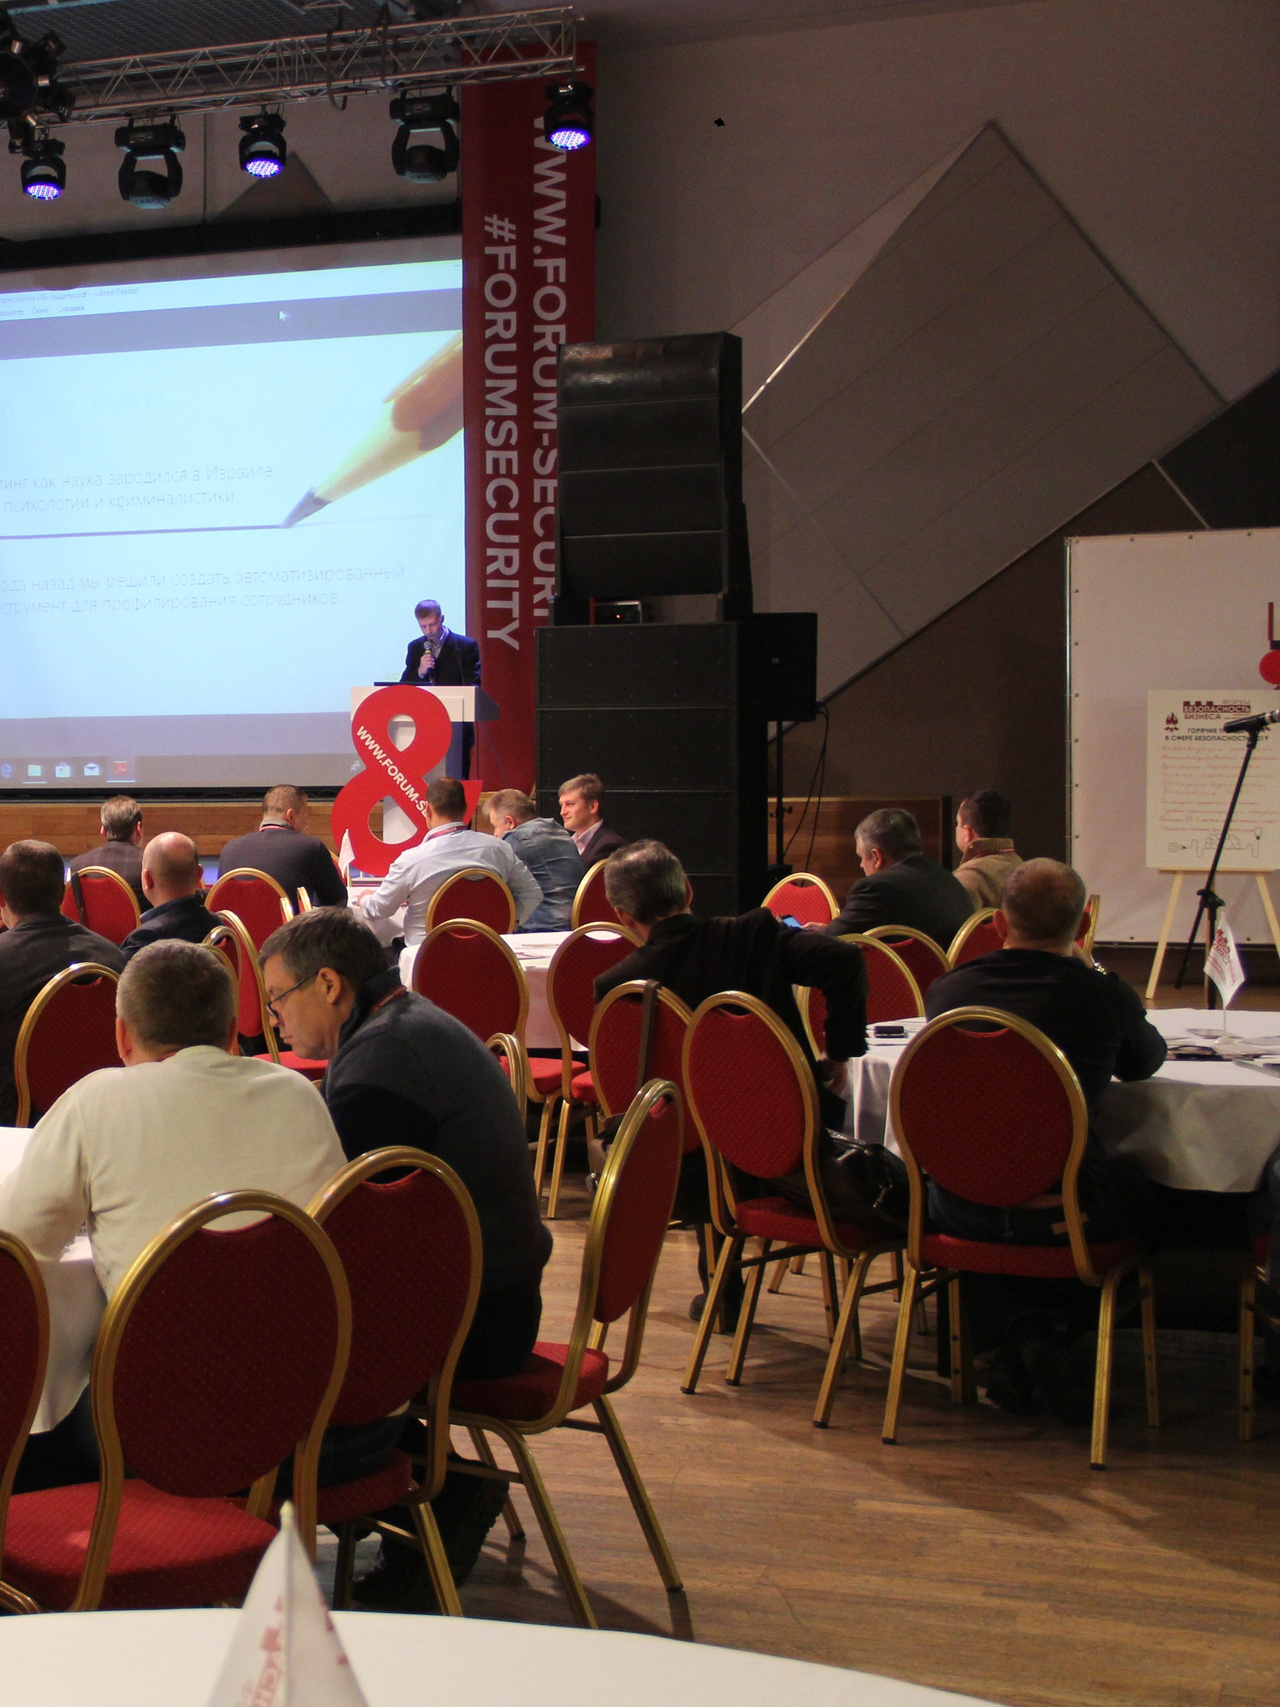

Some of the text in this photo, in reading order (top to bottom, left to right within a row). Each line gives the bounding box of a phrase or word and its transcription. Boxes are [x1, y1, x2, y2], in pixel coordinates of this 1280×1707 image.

[33, 477, 55, 488] как
[61, 475, 103, 490] наука
[108, 470, 186, 487] зародился
[207, 466, 273, 481] Израиле
[484, 214, 520, 651] #FORUMSECURITY
[533, 115, 567, 617] WW.FORUM-SECUR
[4, 498, 89, 512] психологии
